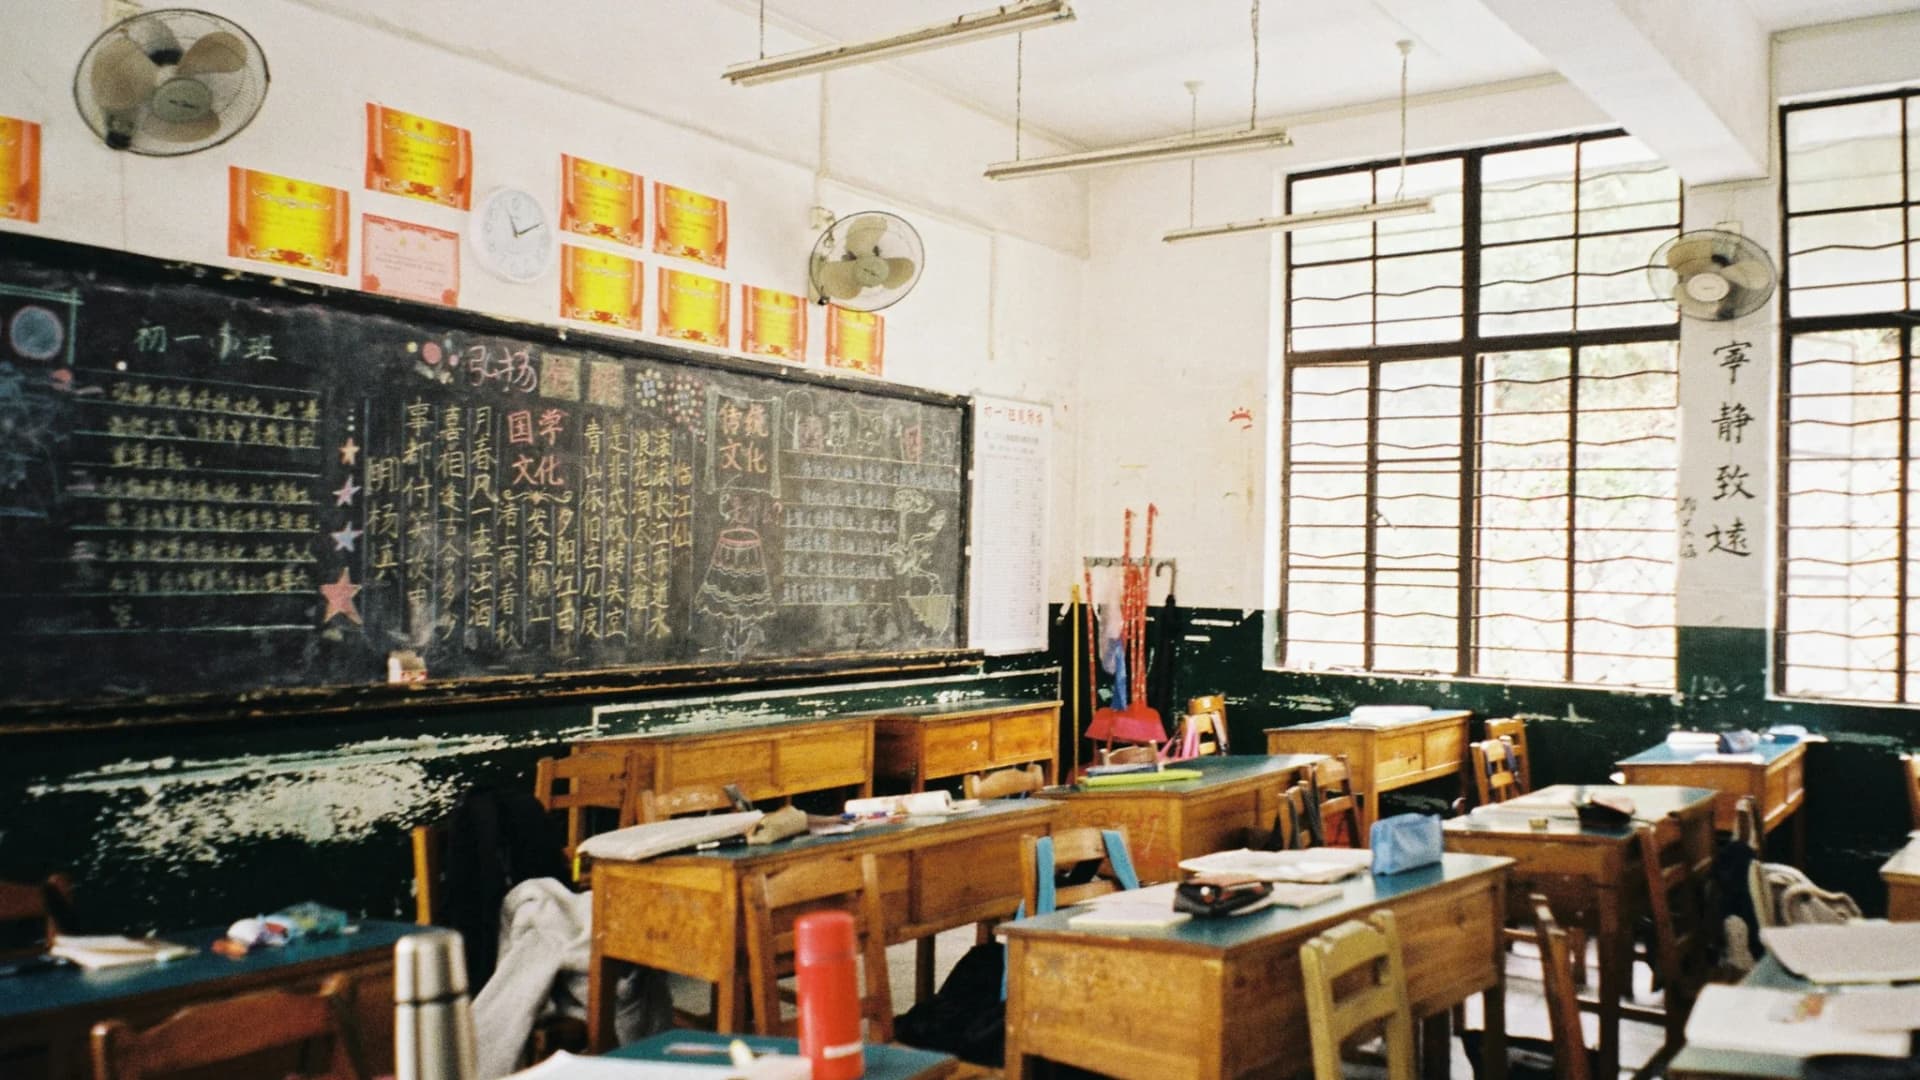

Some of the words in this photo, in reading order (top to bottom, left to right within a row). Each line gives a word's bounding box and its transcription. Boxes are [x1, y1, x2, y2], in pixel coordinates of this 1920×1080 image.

[507, 408, 569, 446] 国学
[511, 453, 564, 486] 文化
[719, 438, 768, 474] 文化
